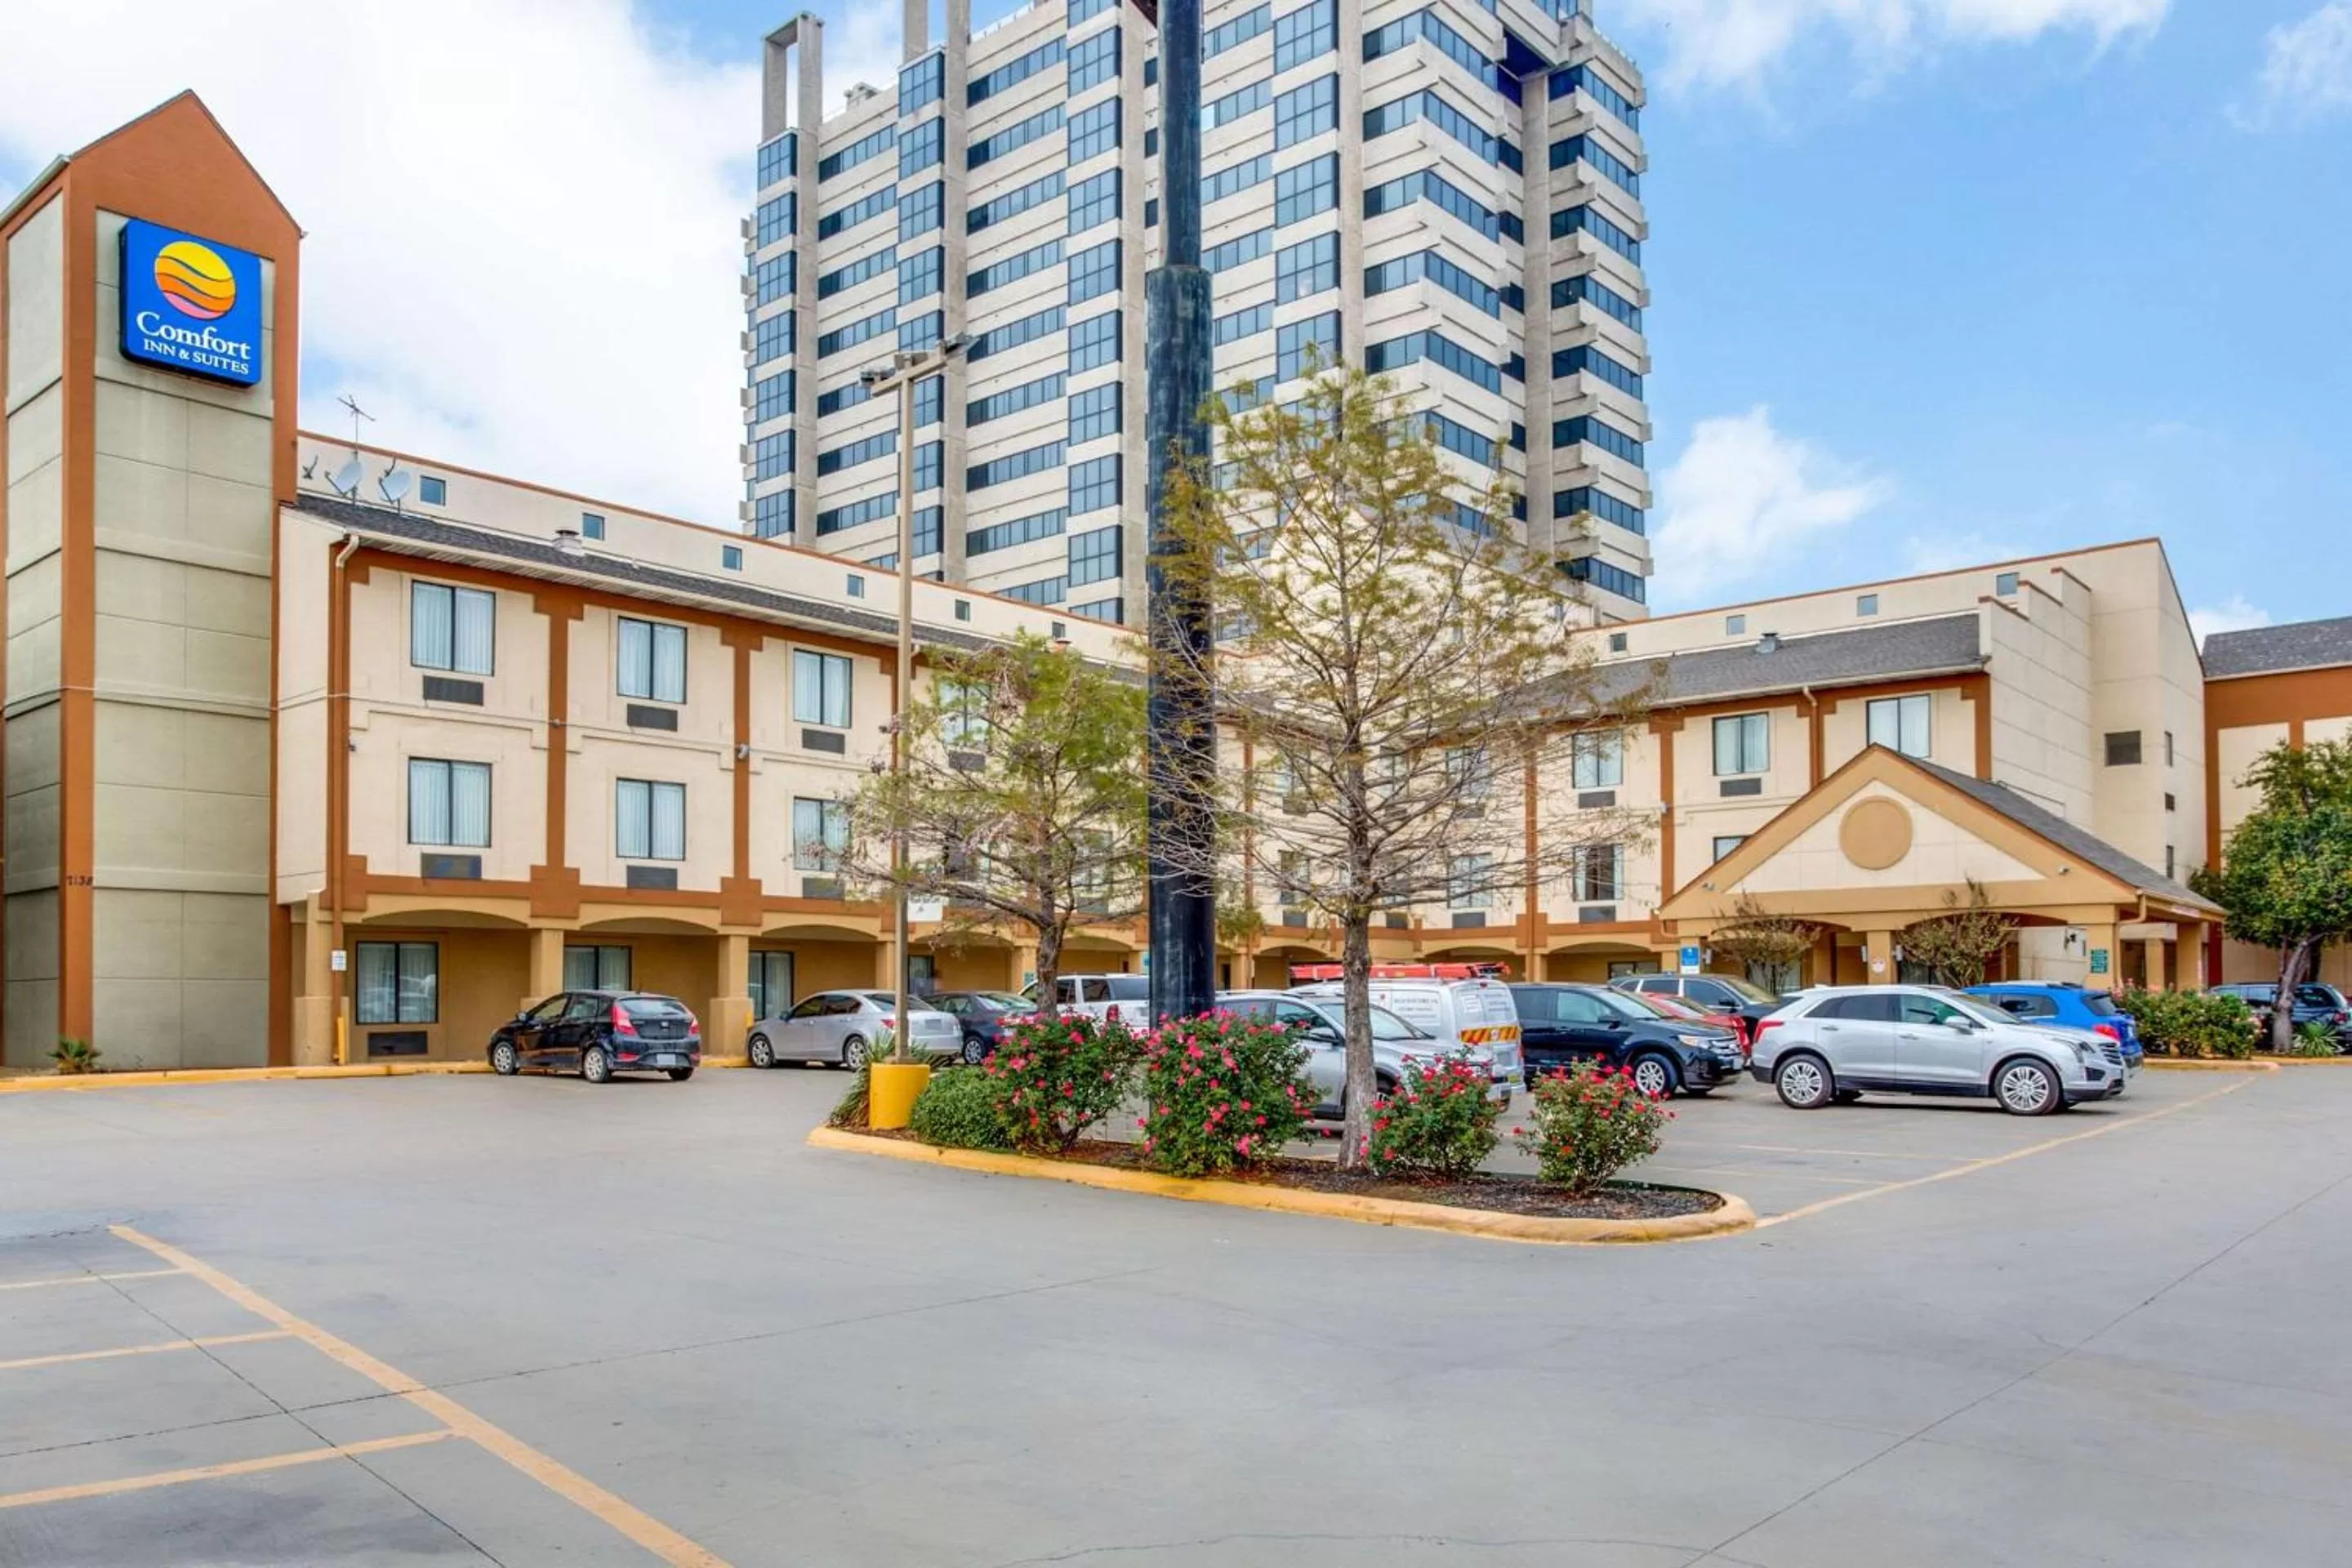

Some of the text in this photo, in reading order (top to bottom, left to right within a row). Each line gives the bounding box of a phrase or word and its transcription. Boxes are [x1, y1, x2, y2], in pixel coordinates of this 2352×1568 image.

[136, 311, 251, 359] Comfort
[144, 339, 249, 375] INN & SUITES
